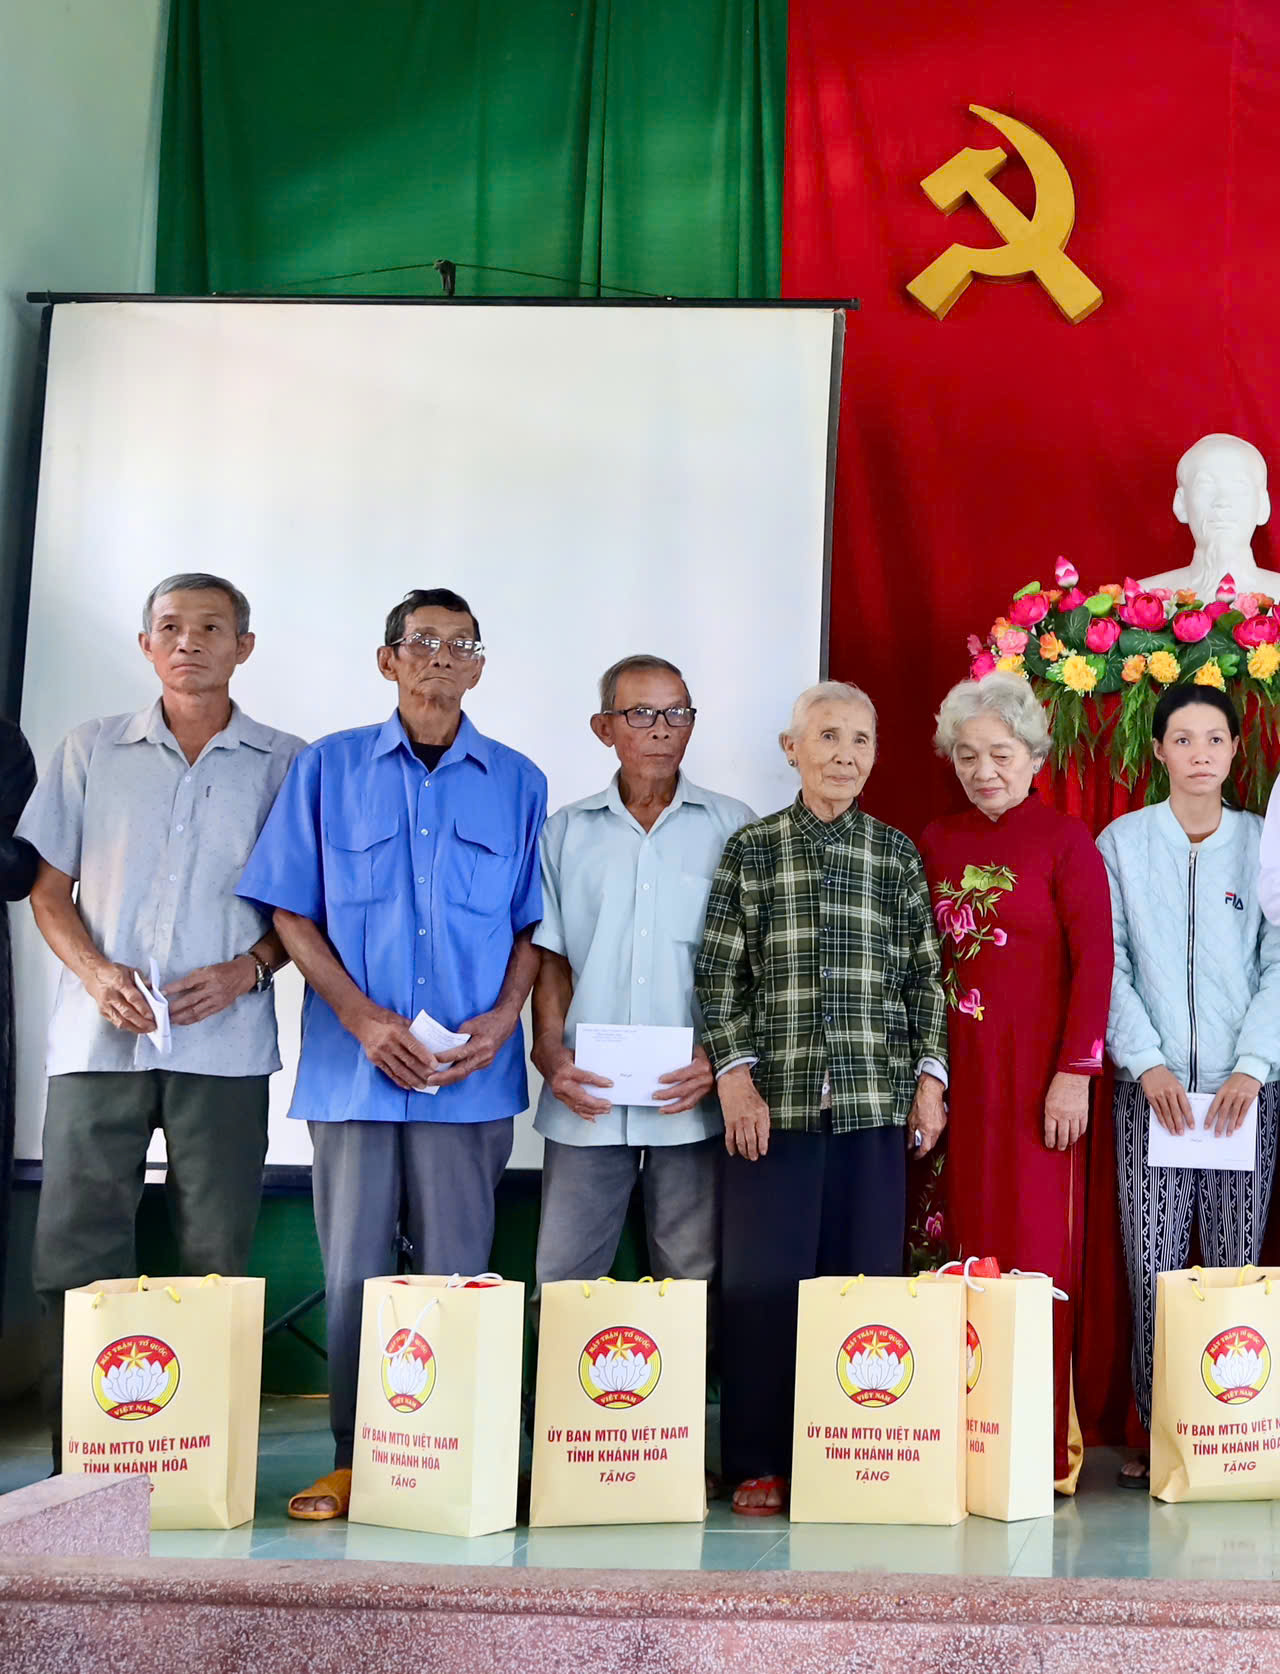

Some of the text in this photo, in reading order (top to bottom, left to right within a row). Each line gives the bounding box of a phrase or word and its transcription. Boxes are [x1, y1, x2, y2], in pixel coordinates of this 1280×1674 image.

[547, 1426, 689, 1444] ỦY BAN MTTQ VIỆT NAM
[807, 1421, 941, 1444] ỦY BAN MTTQ VIỆT NAM
[980, 1421, 1000, 1435] NAM
[1176, 1419, 1189, 1435] ỦY
[1192, 1424, 1215, 1436] BAN
[1218, 1422, 1248, 1436] MTTQ
[1251, 1418, 1272, 1434] VIỆT
[68, 1435, 211, 1455] ỦY BAN MTTQ VIỆT NAM
[362, 1422, 459, 1452] ỦY BAN MTTQ VIỆT NAM
[567, 1445, 668, 1462] TỈNH KHÁNH HÒA
[825, 1443, 920, 1462] TỈNH KHÁNH HÒA
[969, 1438, 985, 1454] HÒA
[1192, 1440, 1218, 1456] TỈNH
[1221, 1439, 1259, 1454] KHÁNH
[83, 1456, 188, 1473] TỈNH KHÁNH HÒA
[372, 1446, 440, 1470] TỈNH KHÁNH HÒA
[855, 1468, 890, 1484] TẶNG
[1223, 1460, 1257, 1475] TẶNG
[391, 1474, 417, 1490] TẶNG
[600, 1469, 636, 1485] TẶNG
